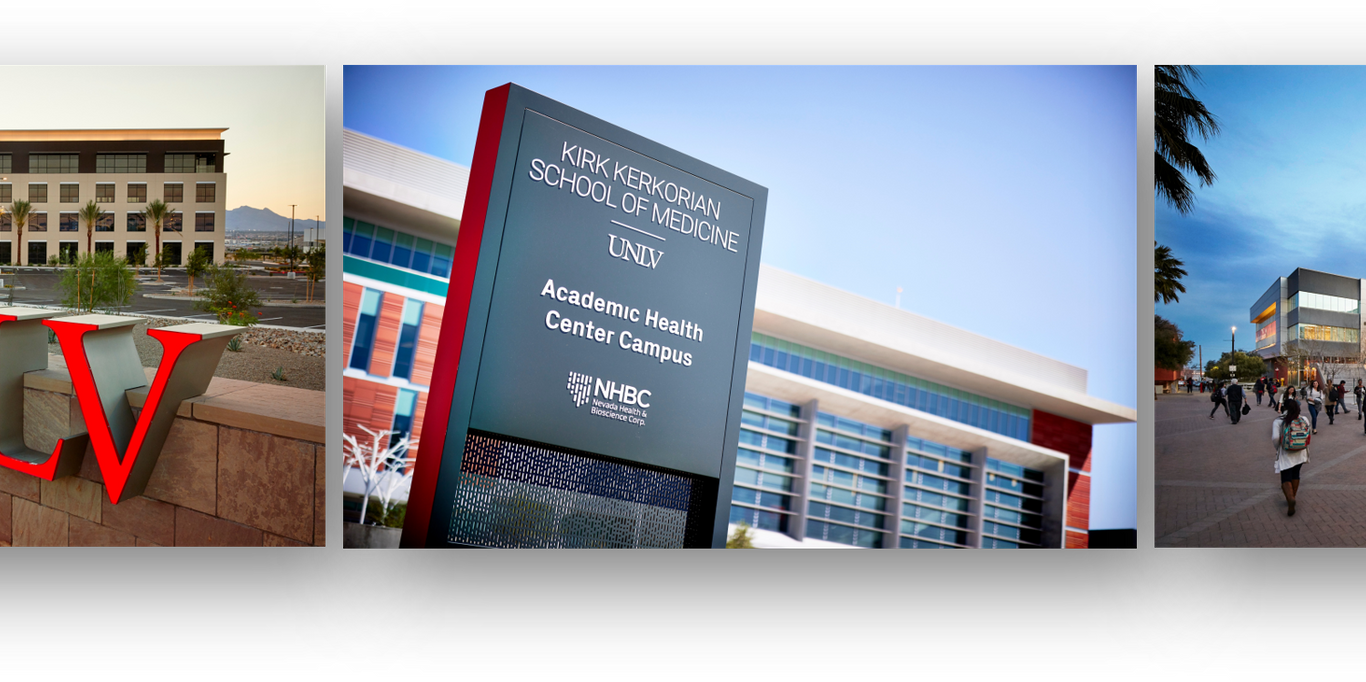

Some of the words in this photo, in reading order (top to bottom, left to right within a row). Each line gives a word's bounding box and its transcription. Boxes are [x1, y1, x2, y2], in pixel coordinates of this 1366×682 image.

[561, 141, 611, 178] KIRK
[613, 161, 721, 220] KERKORIAN
[529, 158, 617, 208] SCHOOL
[621, 192, 649, 217] OF
[651, 202, 739, 253] MEDICINE
[608, 233, 664, 269] UNLV
[540, 278, 640, 322] Academic
[644, 308, 704, 342] Health
[545, 310, 615, 344] Center
[619, 330, 693, 366] Campus
[592, 398, 618, 411] Nevada
[619, 405, 641, 417] Health
[641, 410, 648, 418] &
[594, 377, 652, 408] NHBC
[591, 406, 628, 422] Bioscience
[628, 415, 646, 426] Corp.
